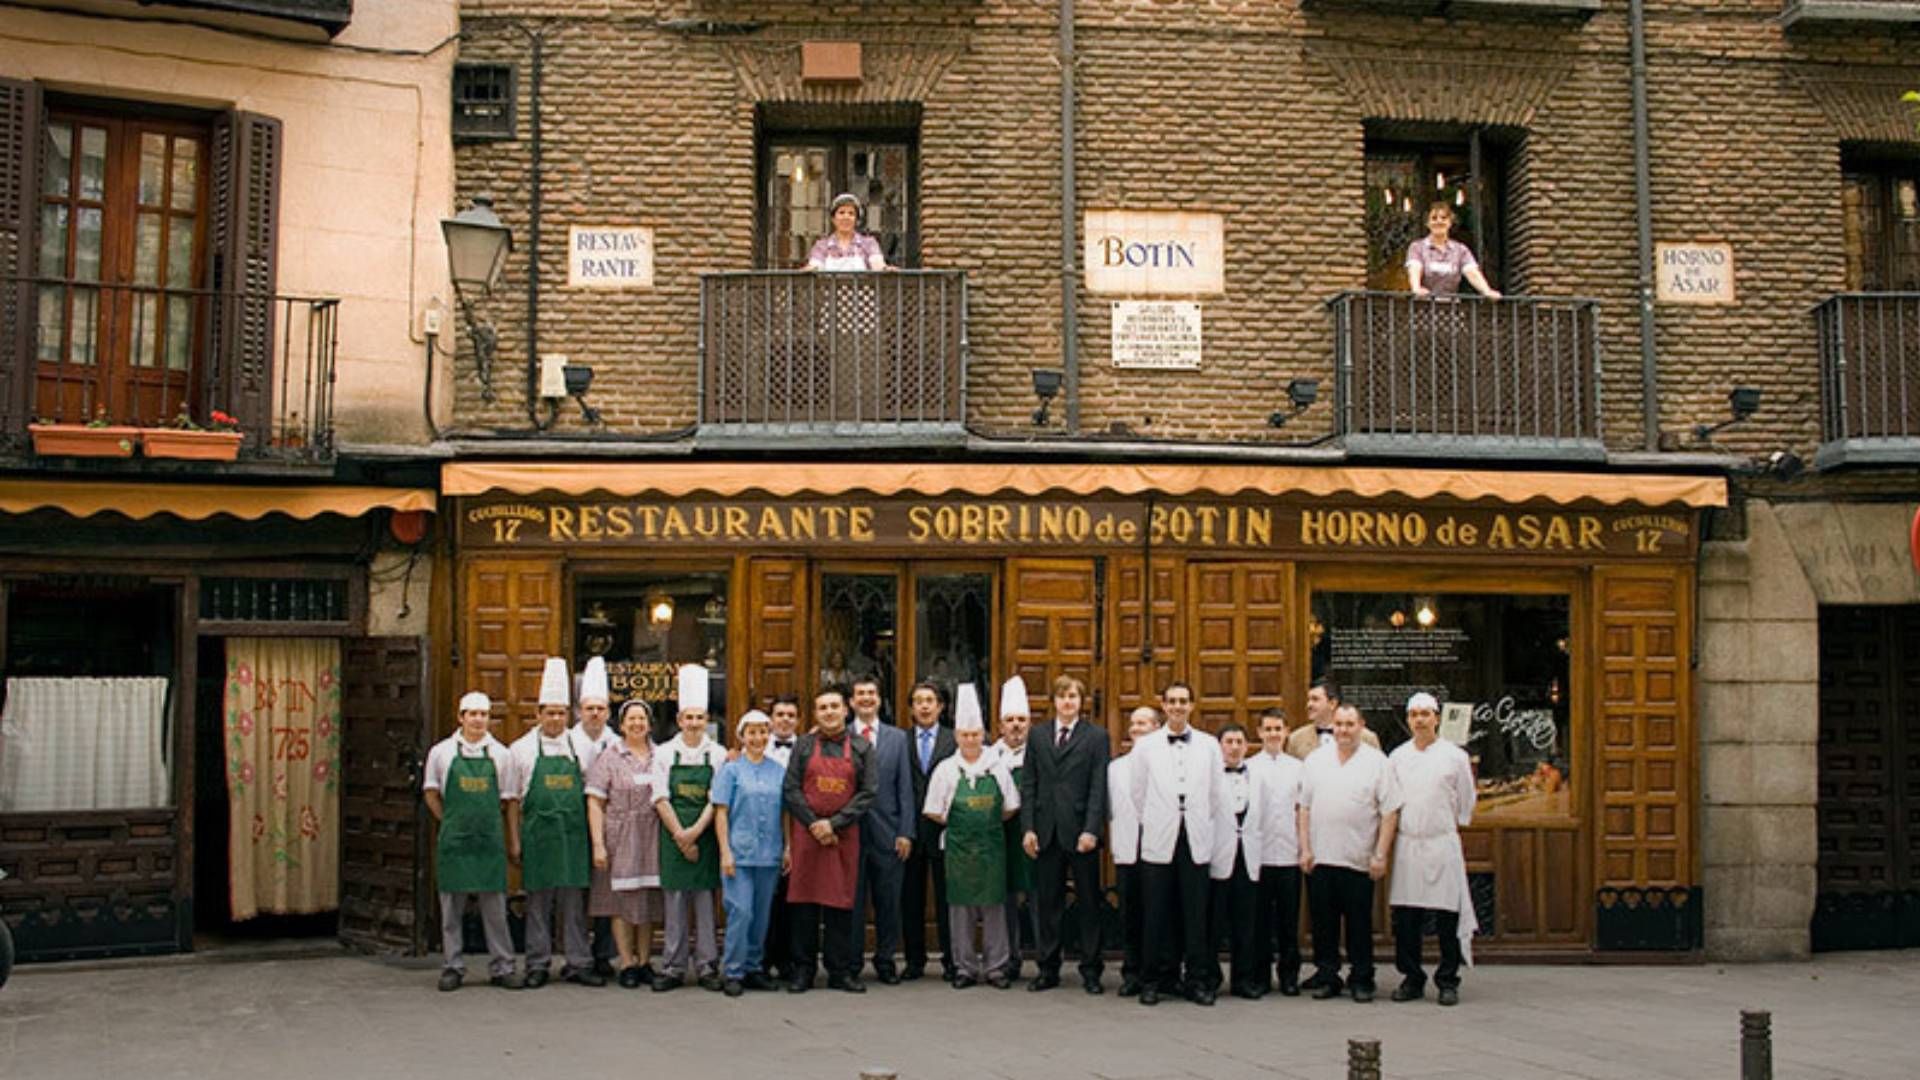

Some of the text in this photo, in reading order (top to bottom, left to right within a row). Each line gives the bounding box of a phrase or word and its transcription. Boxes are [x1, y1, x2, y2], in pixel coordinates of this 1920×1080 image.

[1663, 249, 1725, 265] HORNO
[581, 258, 641, 277] RANTE
[1669, 273, 1720, 293] ASAR
[494, 519, 522, 543] 17
[549, 505, 1606, 551] RESTAURANTE SOBRINO de BOTIN HORNO de ASAR
[1635, 529, 1663, 553] 17
[612, 674, 680, 690] BOTI
